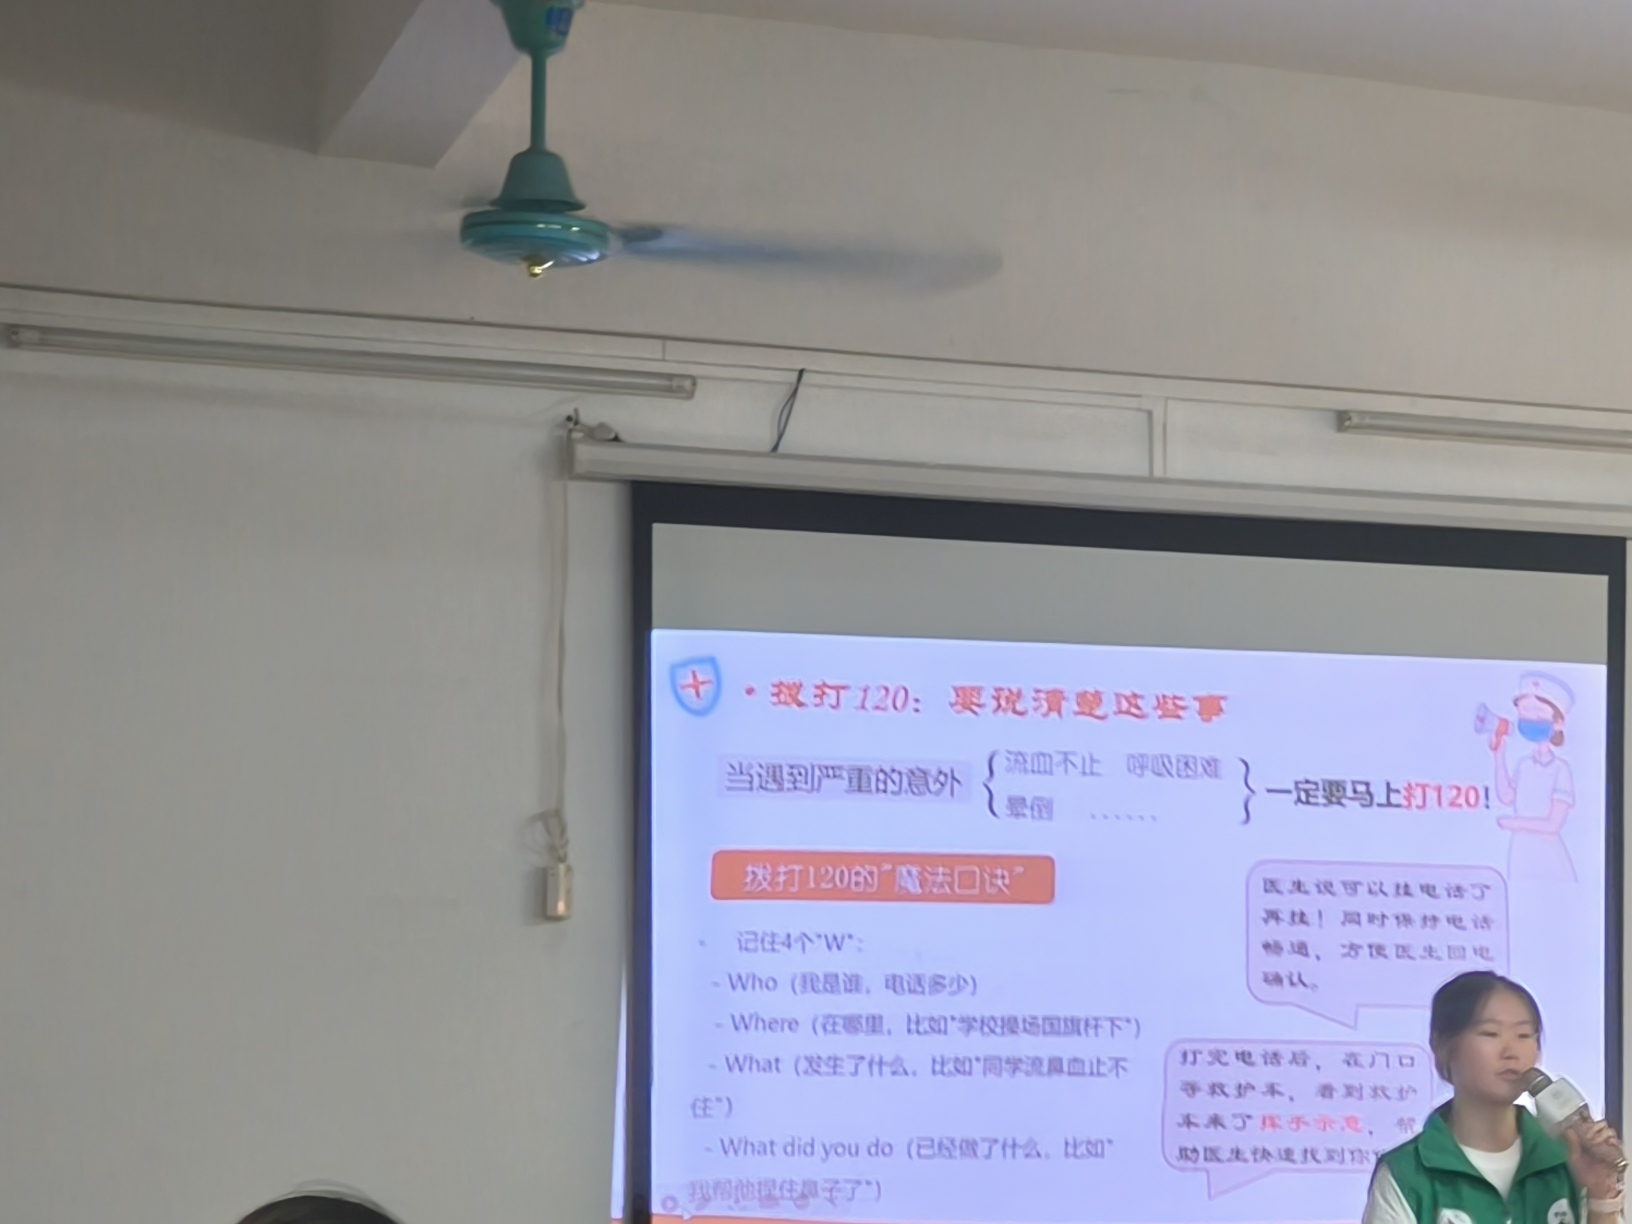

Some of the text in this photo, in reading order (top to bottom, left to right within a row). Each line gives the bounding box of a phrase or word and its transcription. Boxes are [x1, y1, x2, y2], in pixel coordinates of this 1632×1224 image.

[726, 761, 962, 798] 当遇到严重的意外
[728, 973, 778, 995] Who
[730, 1012, 800, 1034] Where
[724, 1054, 781, 1074] What
[719, 1136, 777, 1158] What
[783, 1136, 815, 1158] did
[820, 1142, 860, 1165] you
[866, 1136, 894, 1158] do
[1176, 1146, 1388, 1166] 助医生快速找到你
